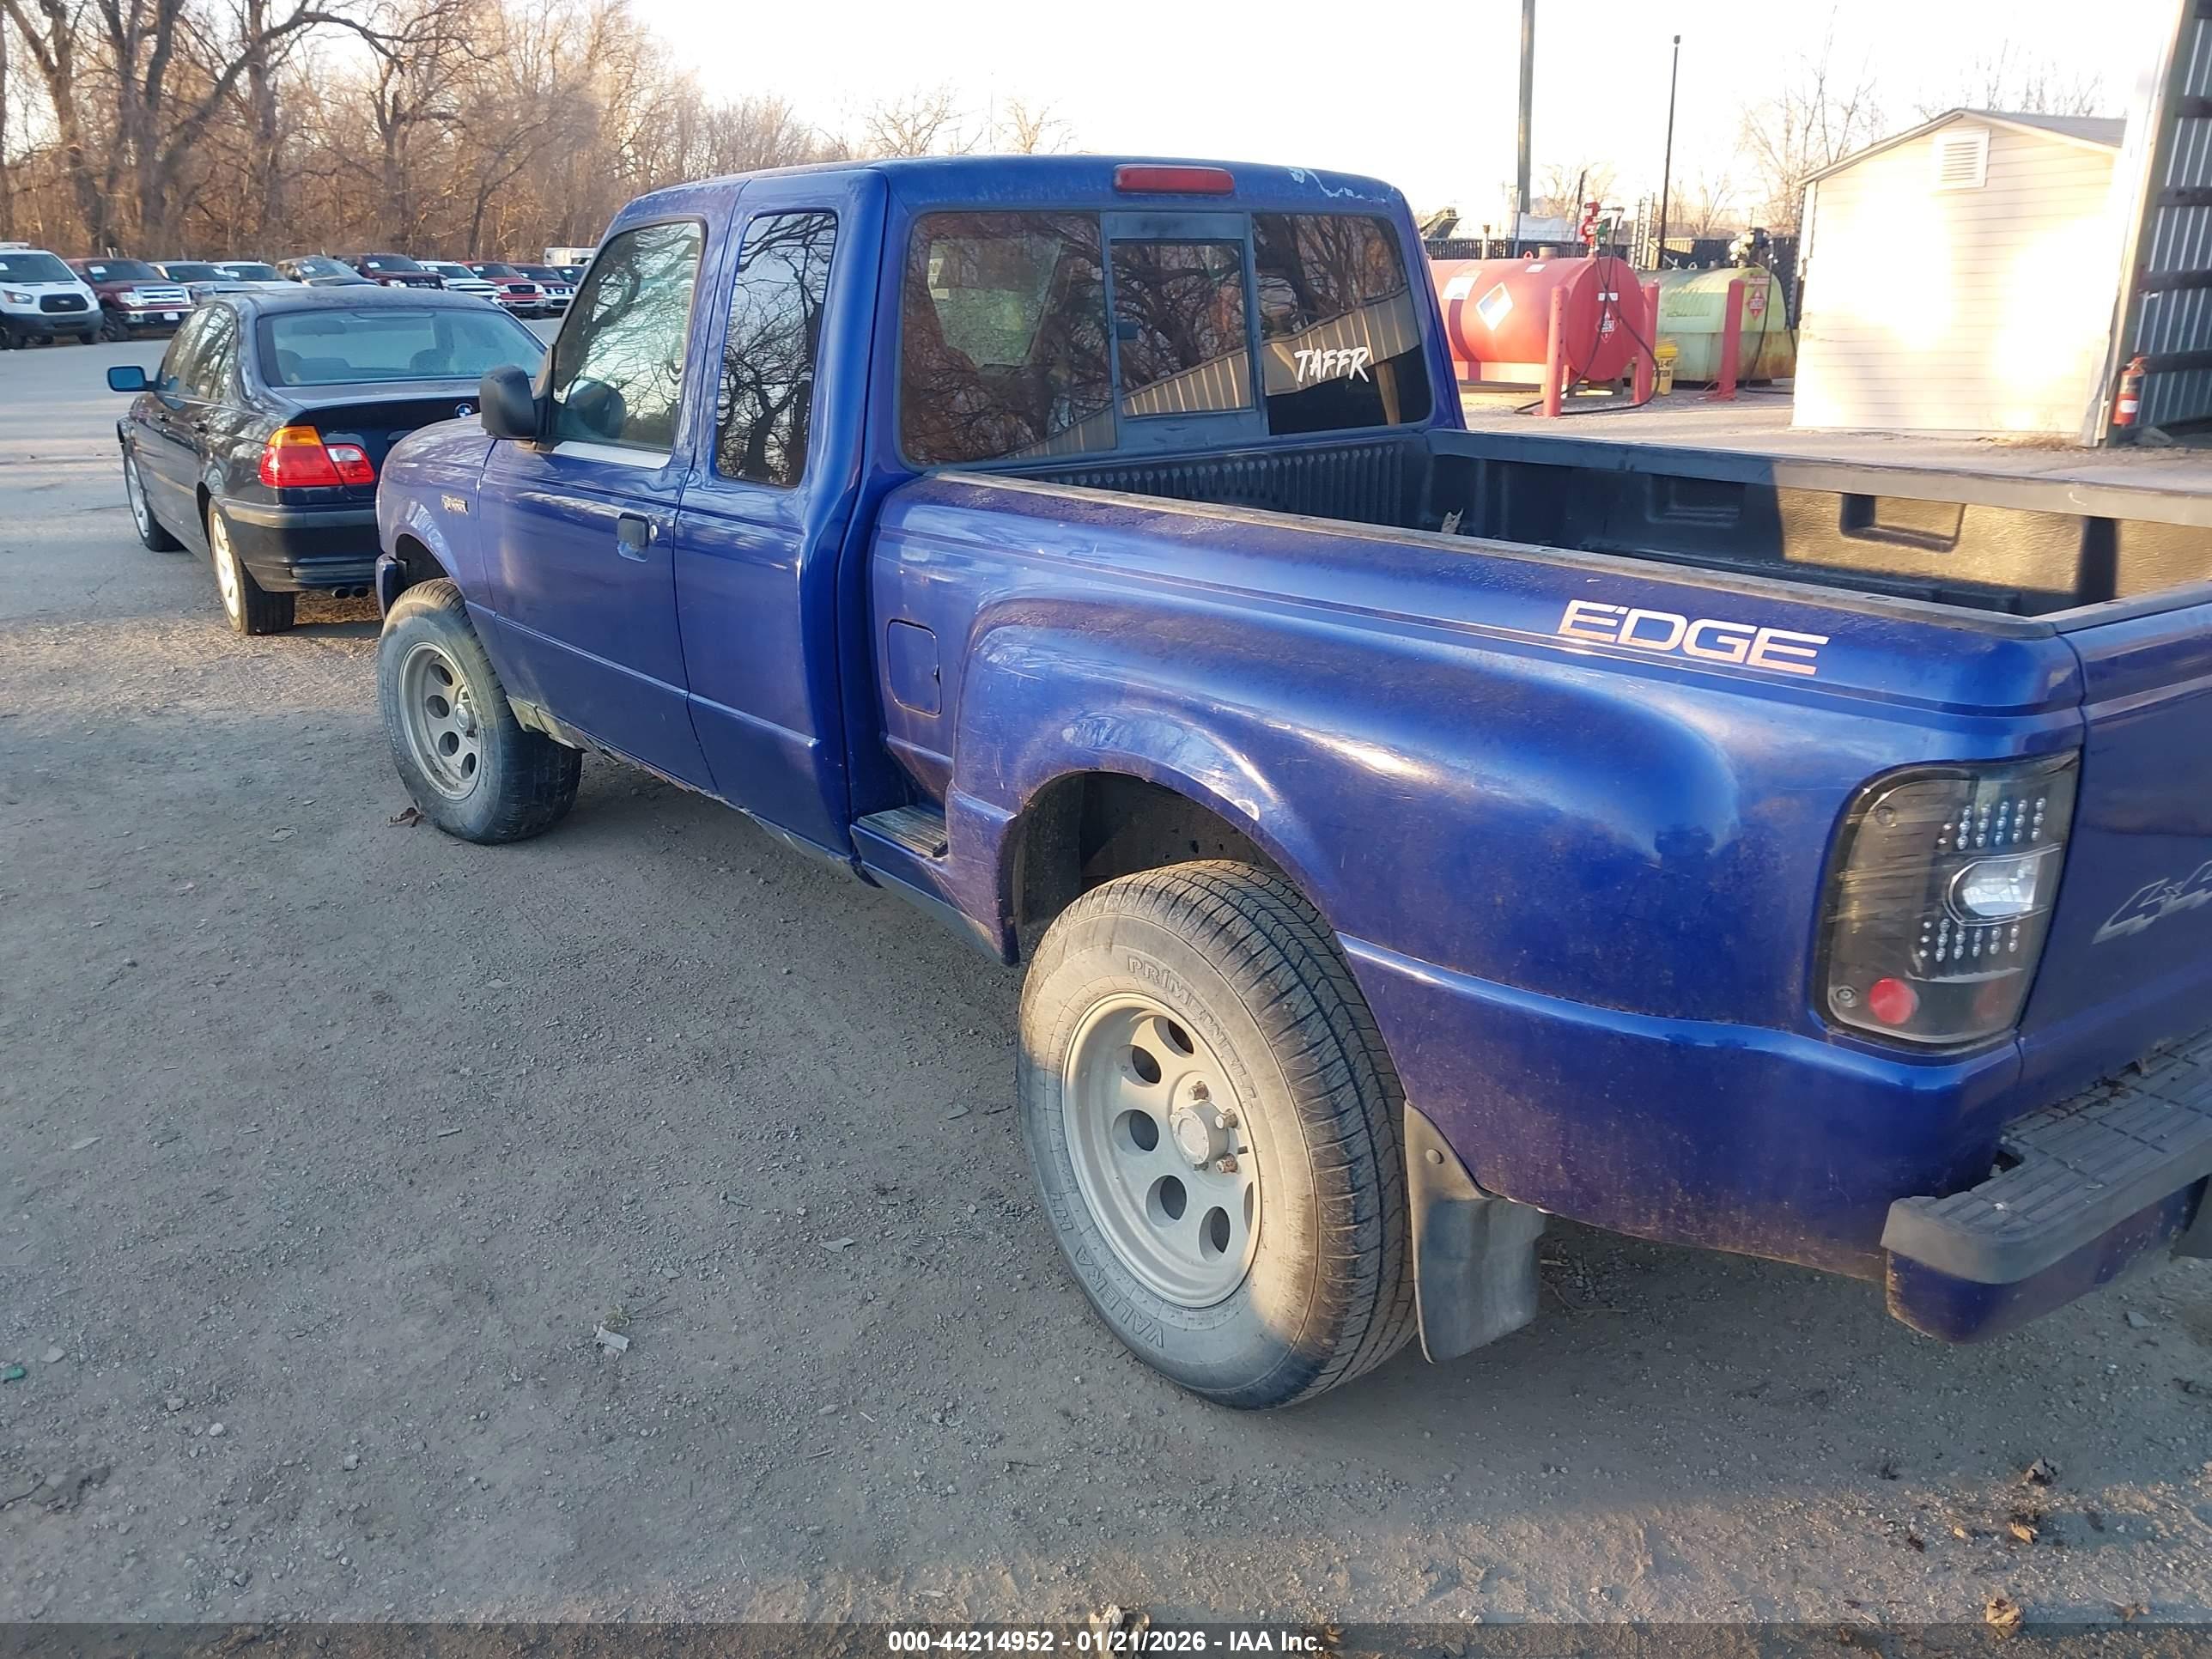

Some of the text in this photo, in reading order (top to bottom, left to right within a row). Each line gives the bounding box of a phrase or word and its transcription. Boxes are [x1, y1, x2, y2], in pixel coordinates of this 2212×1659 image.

[1293, 346, 1370, 383] TAFFR
[1557, 599, 1831, 676] EDGE
[1127, 955, 1258, 1109] PRIMEWELL
[1074, 1244, 1164, 1348] VALERA
